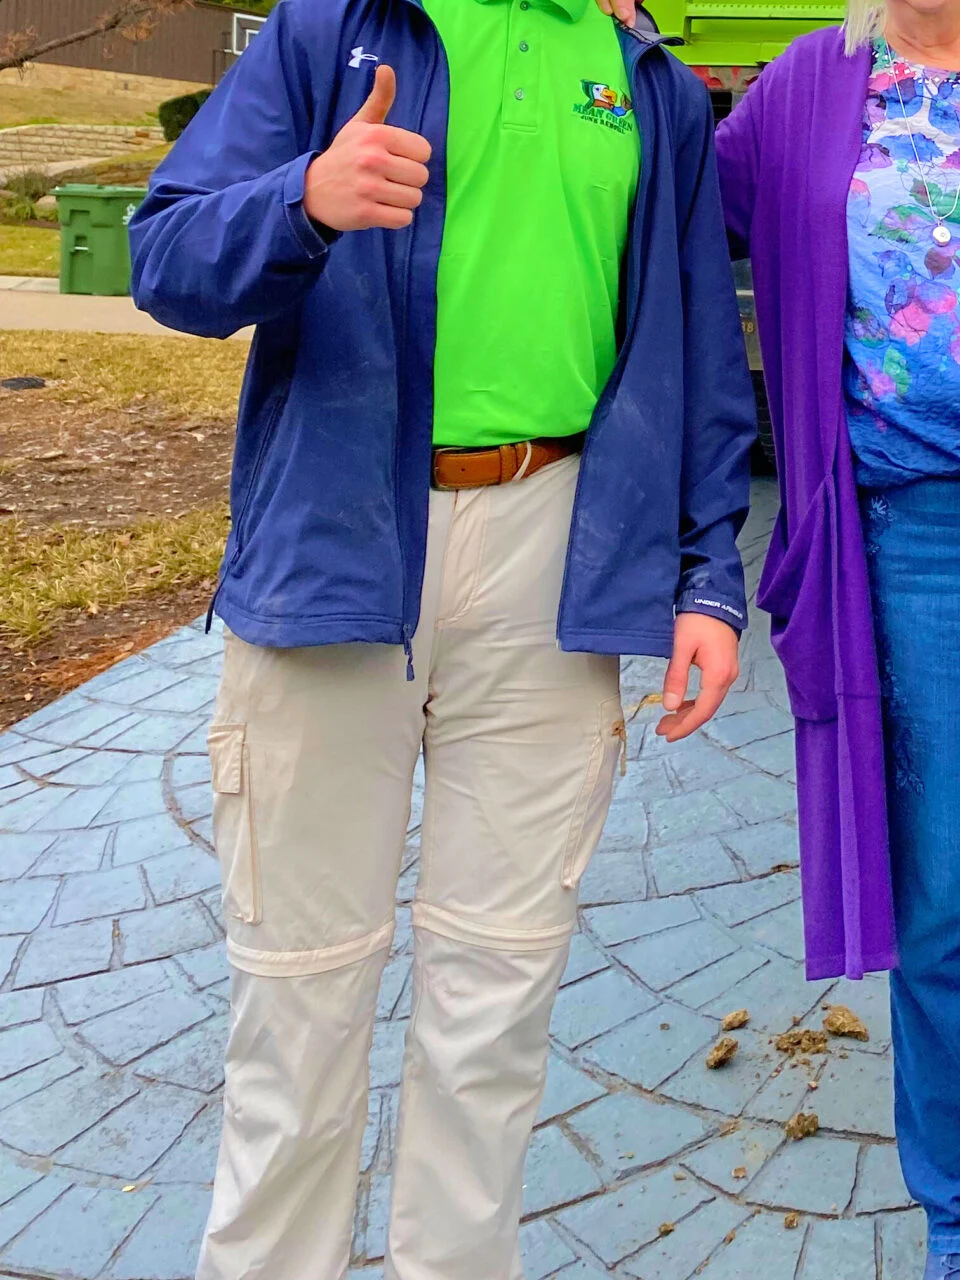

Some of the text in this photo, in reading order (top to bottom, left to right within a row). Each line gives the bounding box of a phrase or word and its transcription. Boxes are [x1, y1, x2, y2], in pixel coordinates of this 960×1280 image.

[573, 104, 633, 131] MEAN GREEN
[694, 598, 720, 608] UNDER
